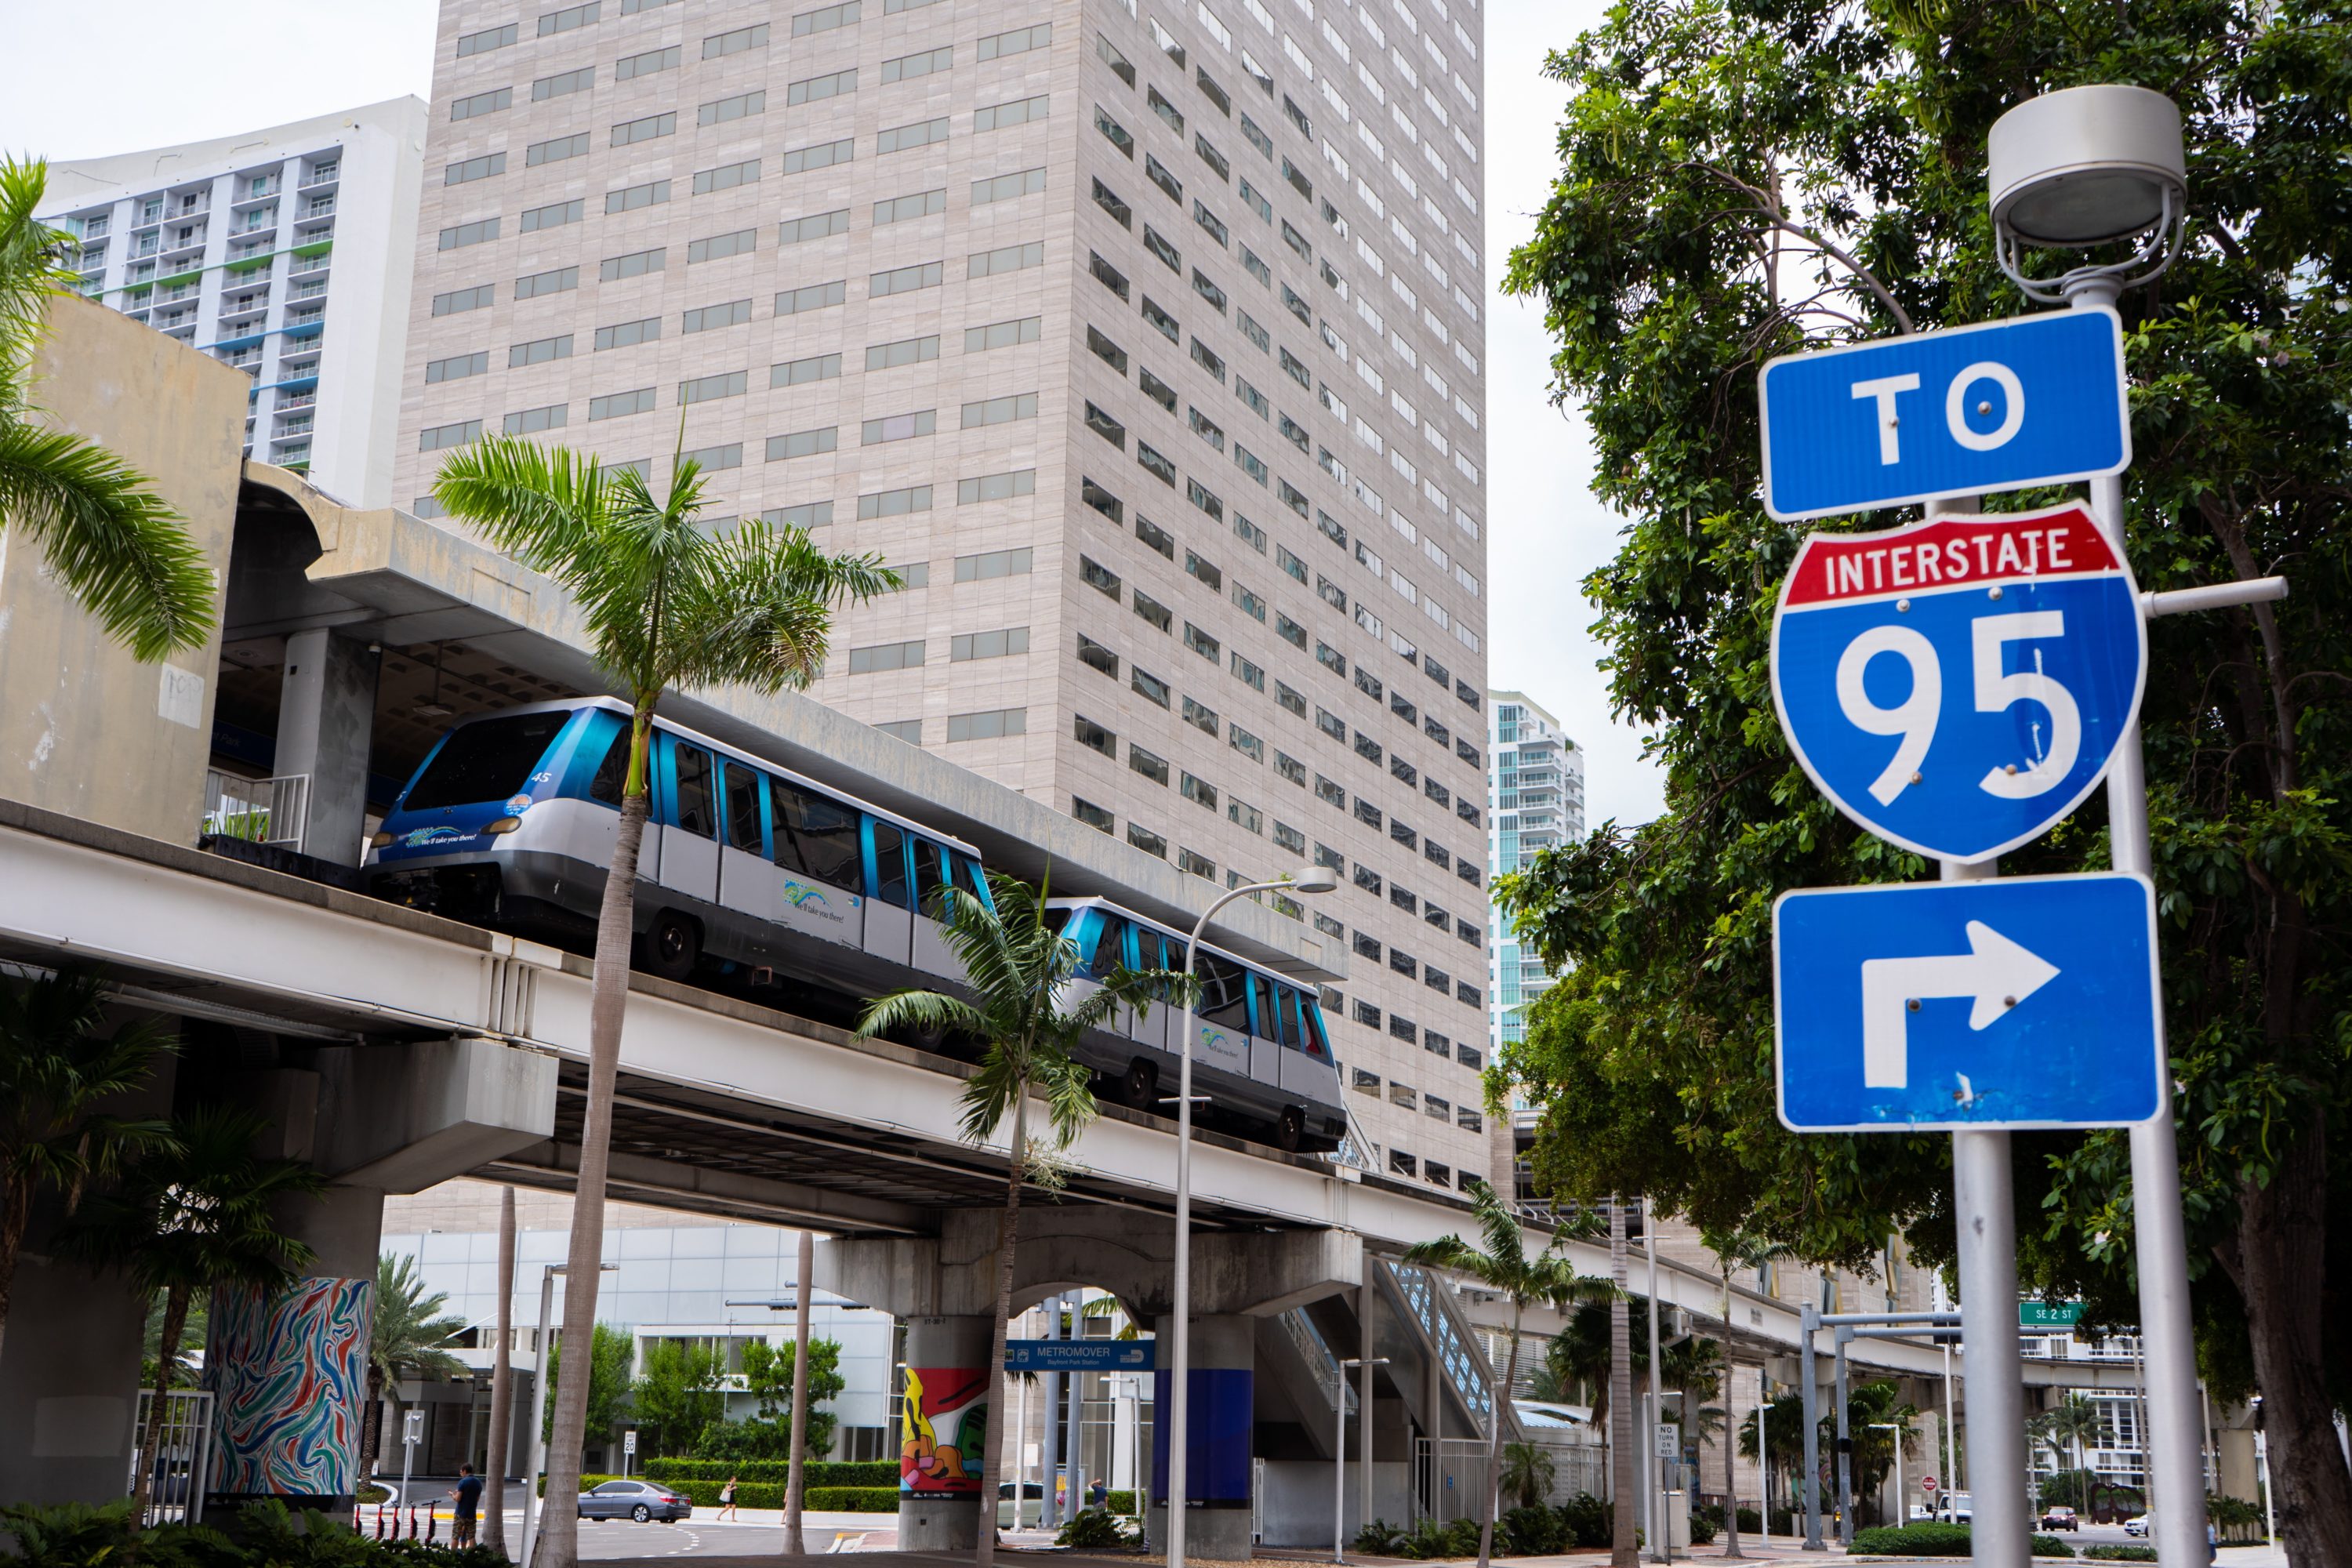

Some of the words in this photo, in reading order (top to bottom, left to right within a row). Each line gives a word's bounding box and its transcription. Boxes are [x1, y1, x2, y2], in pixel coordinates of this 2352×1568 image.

[1851, 361, 2026, 466] TO
[1825, 528, 2073, 595] INTERSTATE
[1835, 610, 2082, 808] 95
[531, 772, 552, 782] 45
[808, 906, 818, 915] take
[819, 911, 829, 920] you
[829, 912, 844, 924] there!
[2036, 1309, 2047, 1319] SE
[2051, 1308, 2057, 1319] 2
[2062, 1310, 2072, 1319] ST
[1037, 1347, 1110, 1357] METROMOVER
[626, 1443, 634, 1451] 20
